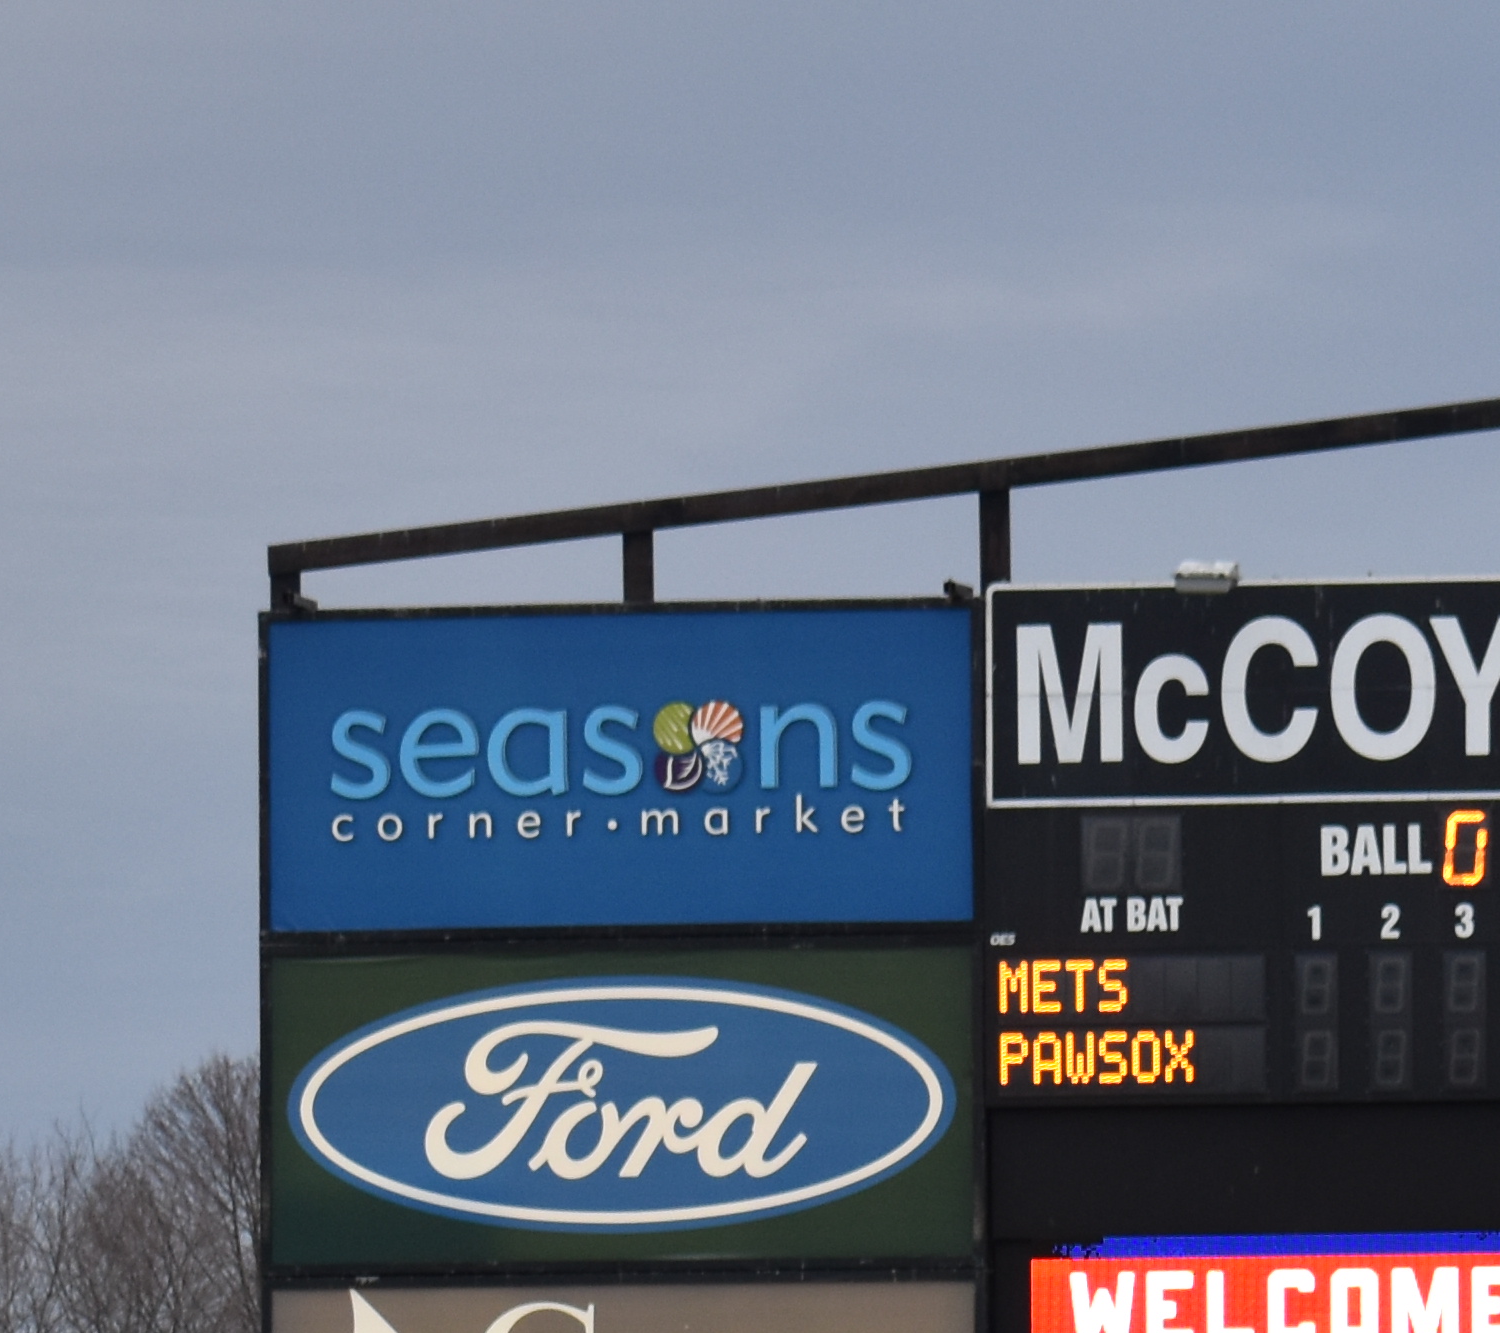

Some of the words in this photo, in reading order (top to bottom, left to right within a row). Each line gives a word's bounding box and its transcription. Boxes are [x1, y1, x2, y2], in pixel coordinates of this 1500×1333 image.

[330, 811, 580, 842] corner
[640, 794, 905, 836] market
[1321, 824, 1431, 876] BALL
[1442, 810, 1487, 886] 0
[1081, 898, 1117, 932] AT
[1127, 897, 1183, 931] BAT
[1307, 906, 1322, 939] 1
[1381, 905, 1399, 939] 2
[1455, 903, 1474, 938] 3
[999, 959, 1128, 1014] METS
[999, 1030, 1195, 1085] PAWSOX
[424, 1019, 818, 1180] Ford
